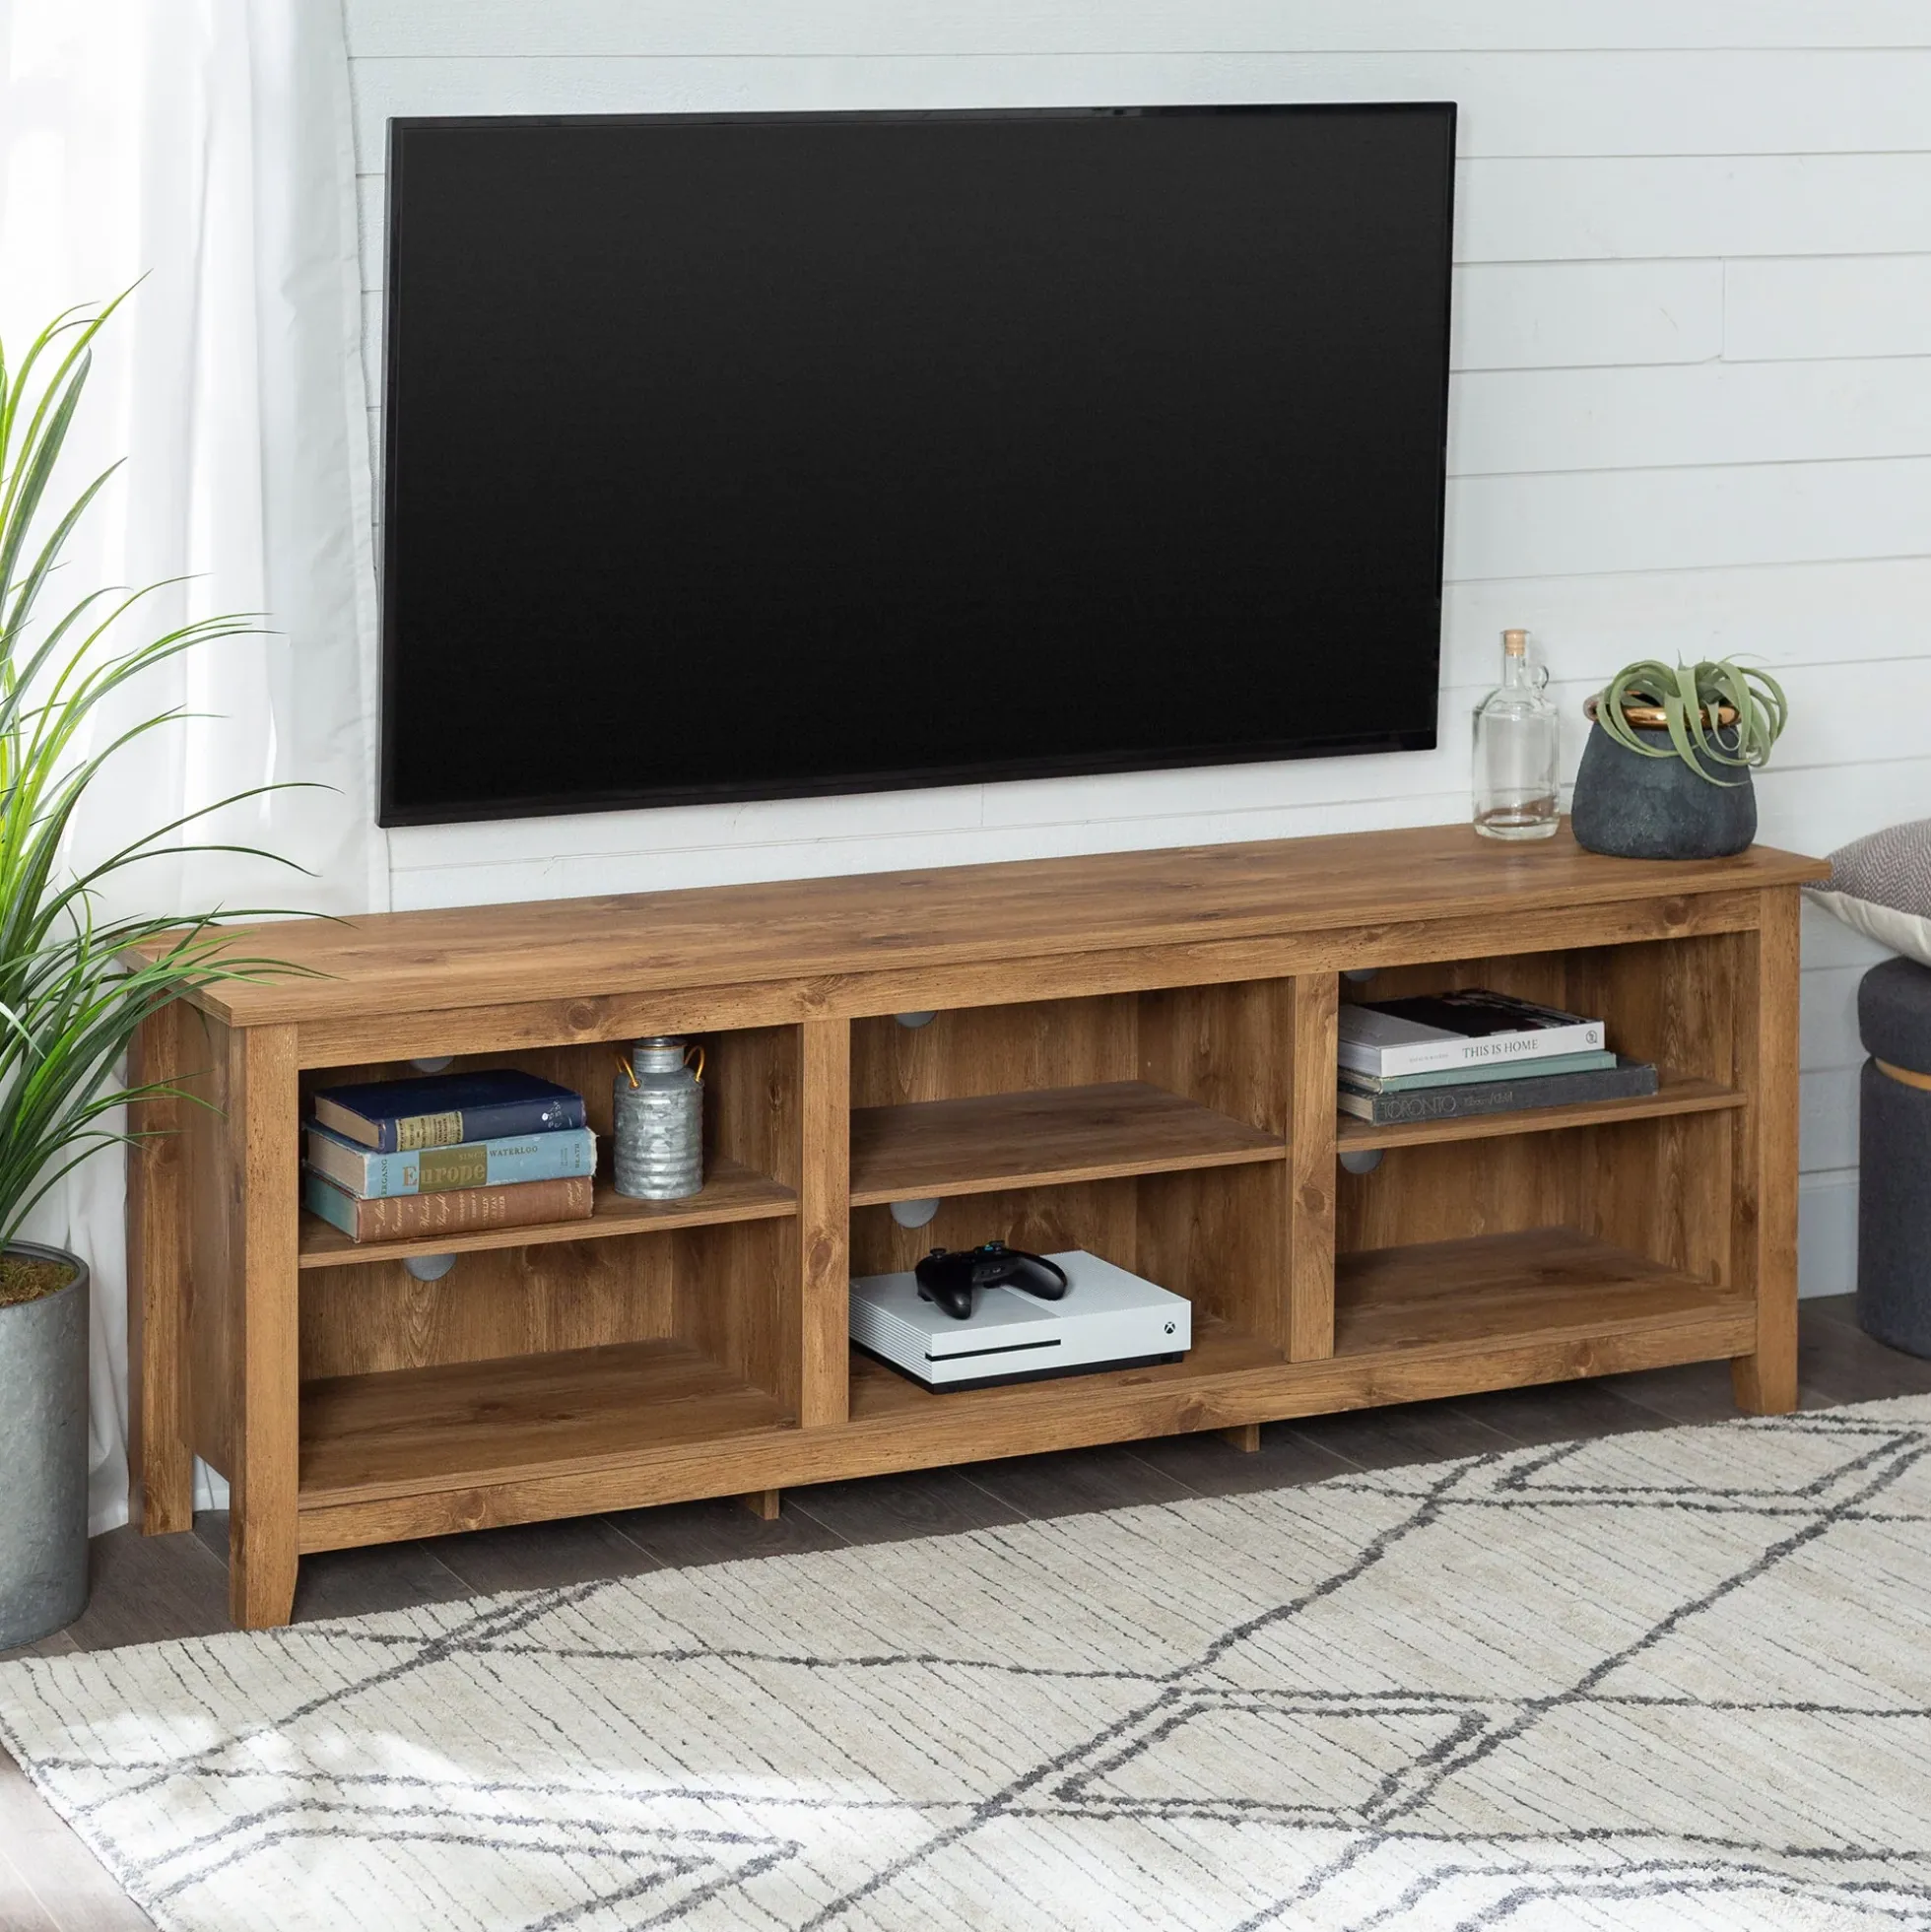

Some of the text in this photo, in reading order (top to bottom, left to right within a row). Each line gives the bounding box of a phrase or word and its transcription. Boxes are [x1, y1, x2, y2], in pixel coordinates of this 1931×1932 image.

[1462, 1045, 1490, 1059] THIS
[1492, 1043, 1501, 1055] IS
[1504, 1038, 1539, 1053] HOME
[1380, 1095, 1457, 1119] TORONTO
[489, 1146, 539, 1158] WATERLOO
[402, 1163, 486, 1186] Europe
